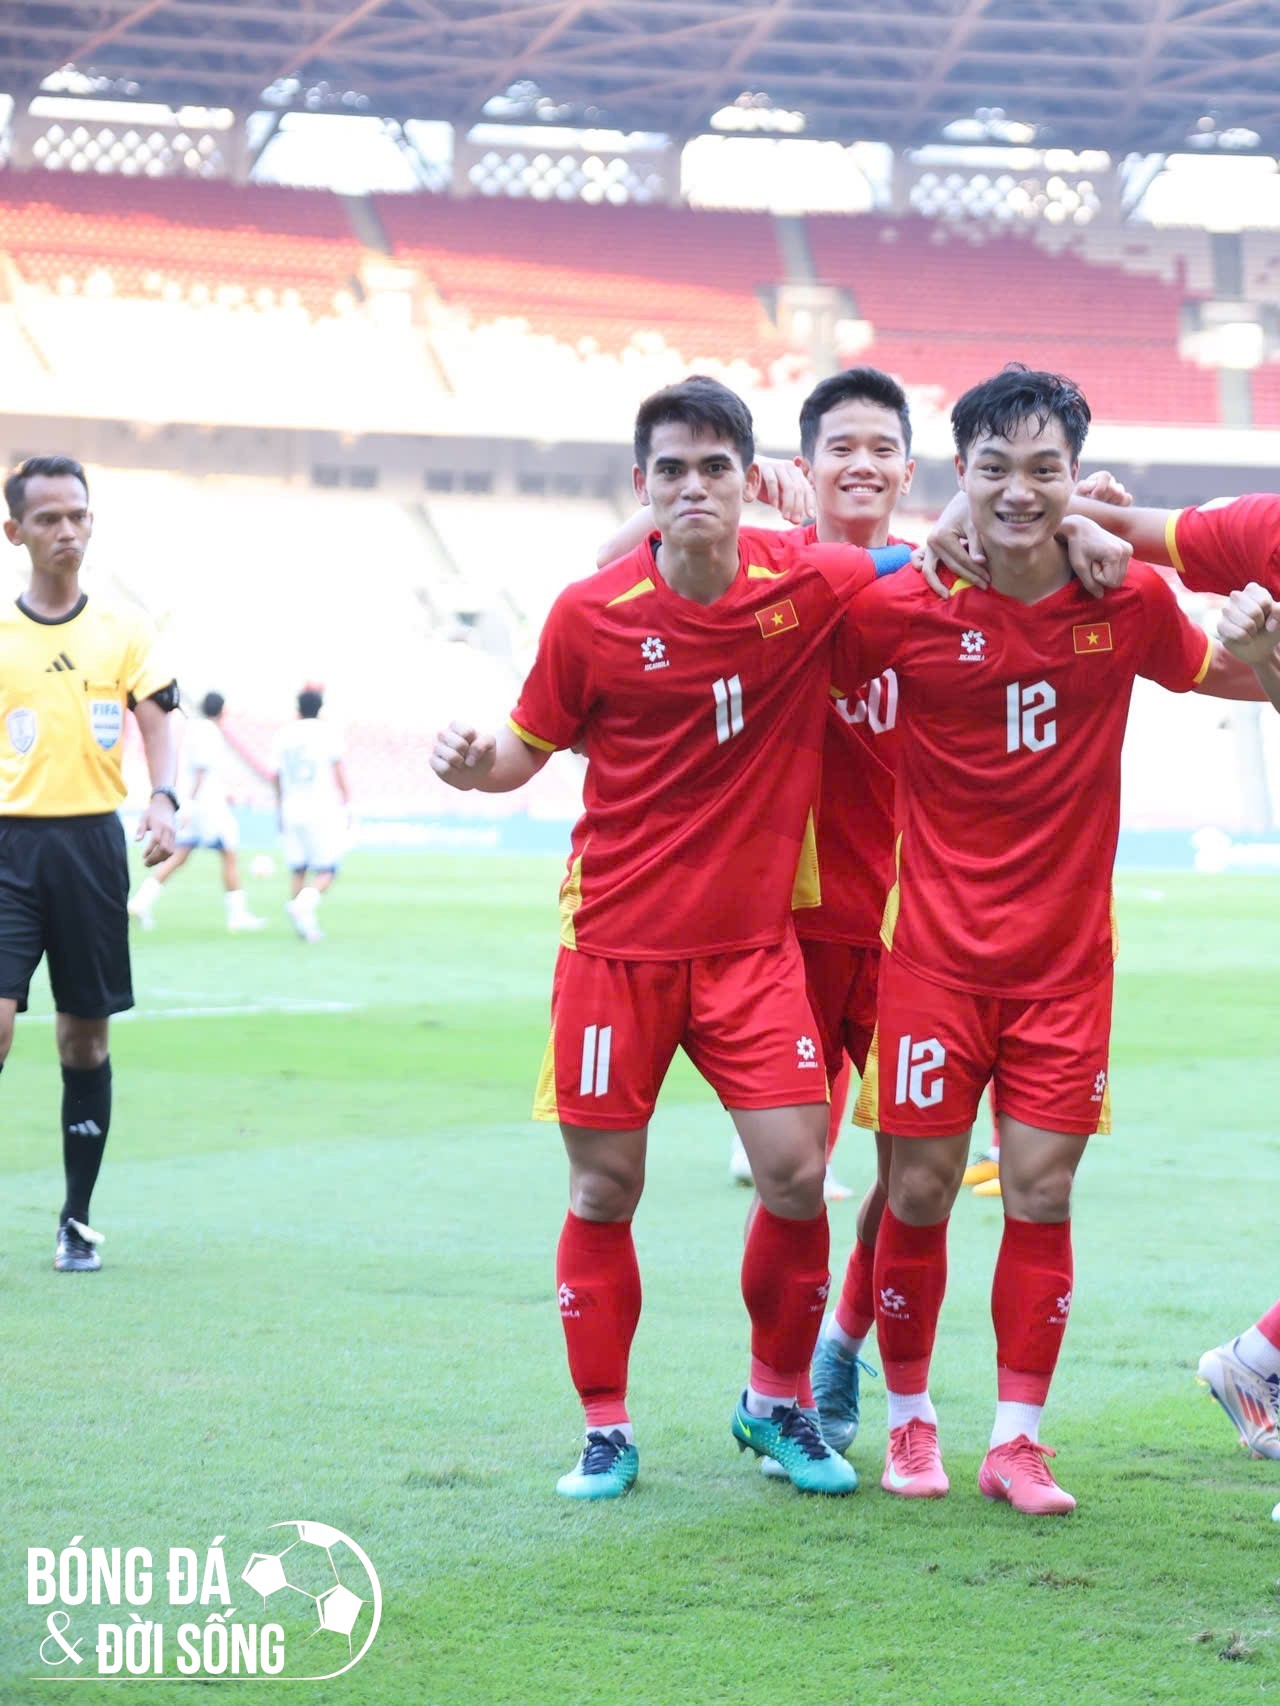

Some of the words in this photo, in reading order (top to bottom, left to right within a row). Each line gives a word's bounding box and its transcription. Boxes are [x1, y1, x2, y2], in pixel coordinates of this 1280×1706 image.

[93, 704, 119, 715] FIFA
[711, 673, 744, 745] 11
[1006, 680, 1057, 754] 12
[579, 1024, 612, 1097] 11
[895, 1034, 946, 1109] 12
